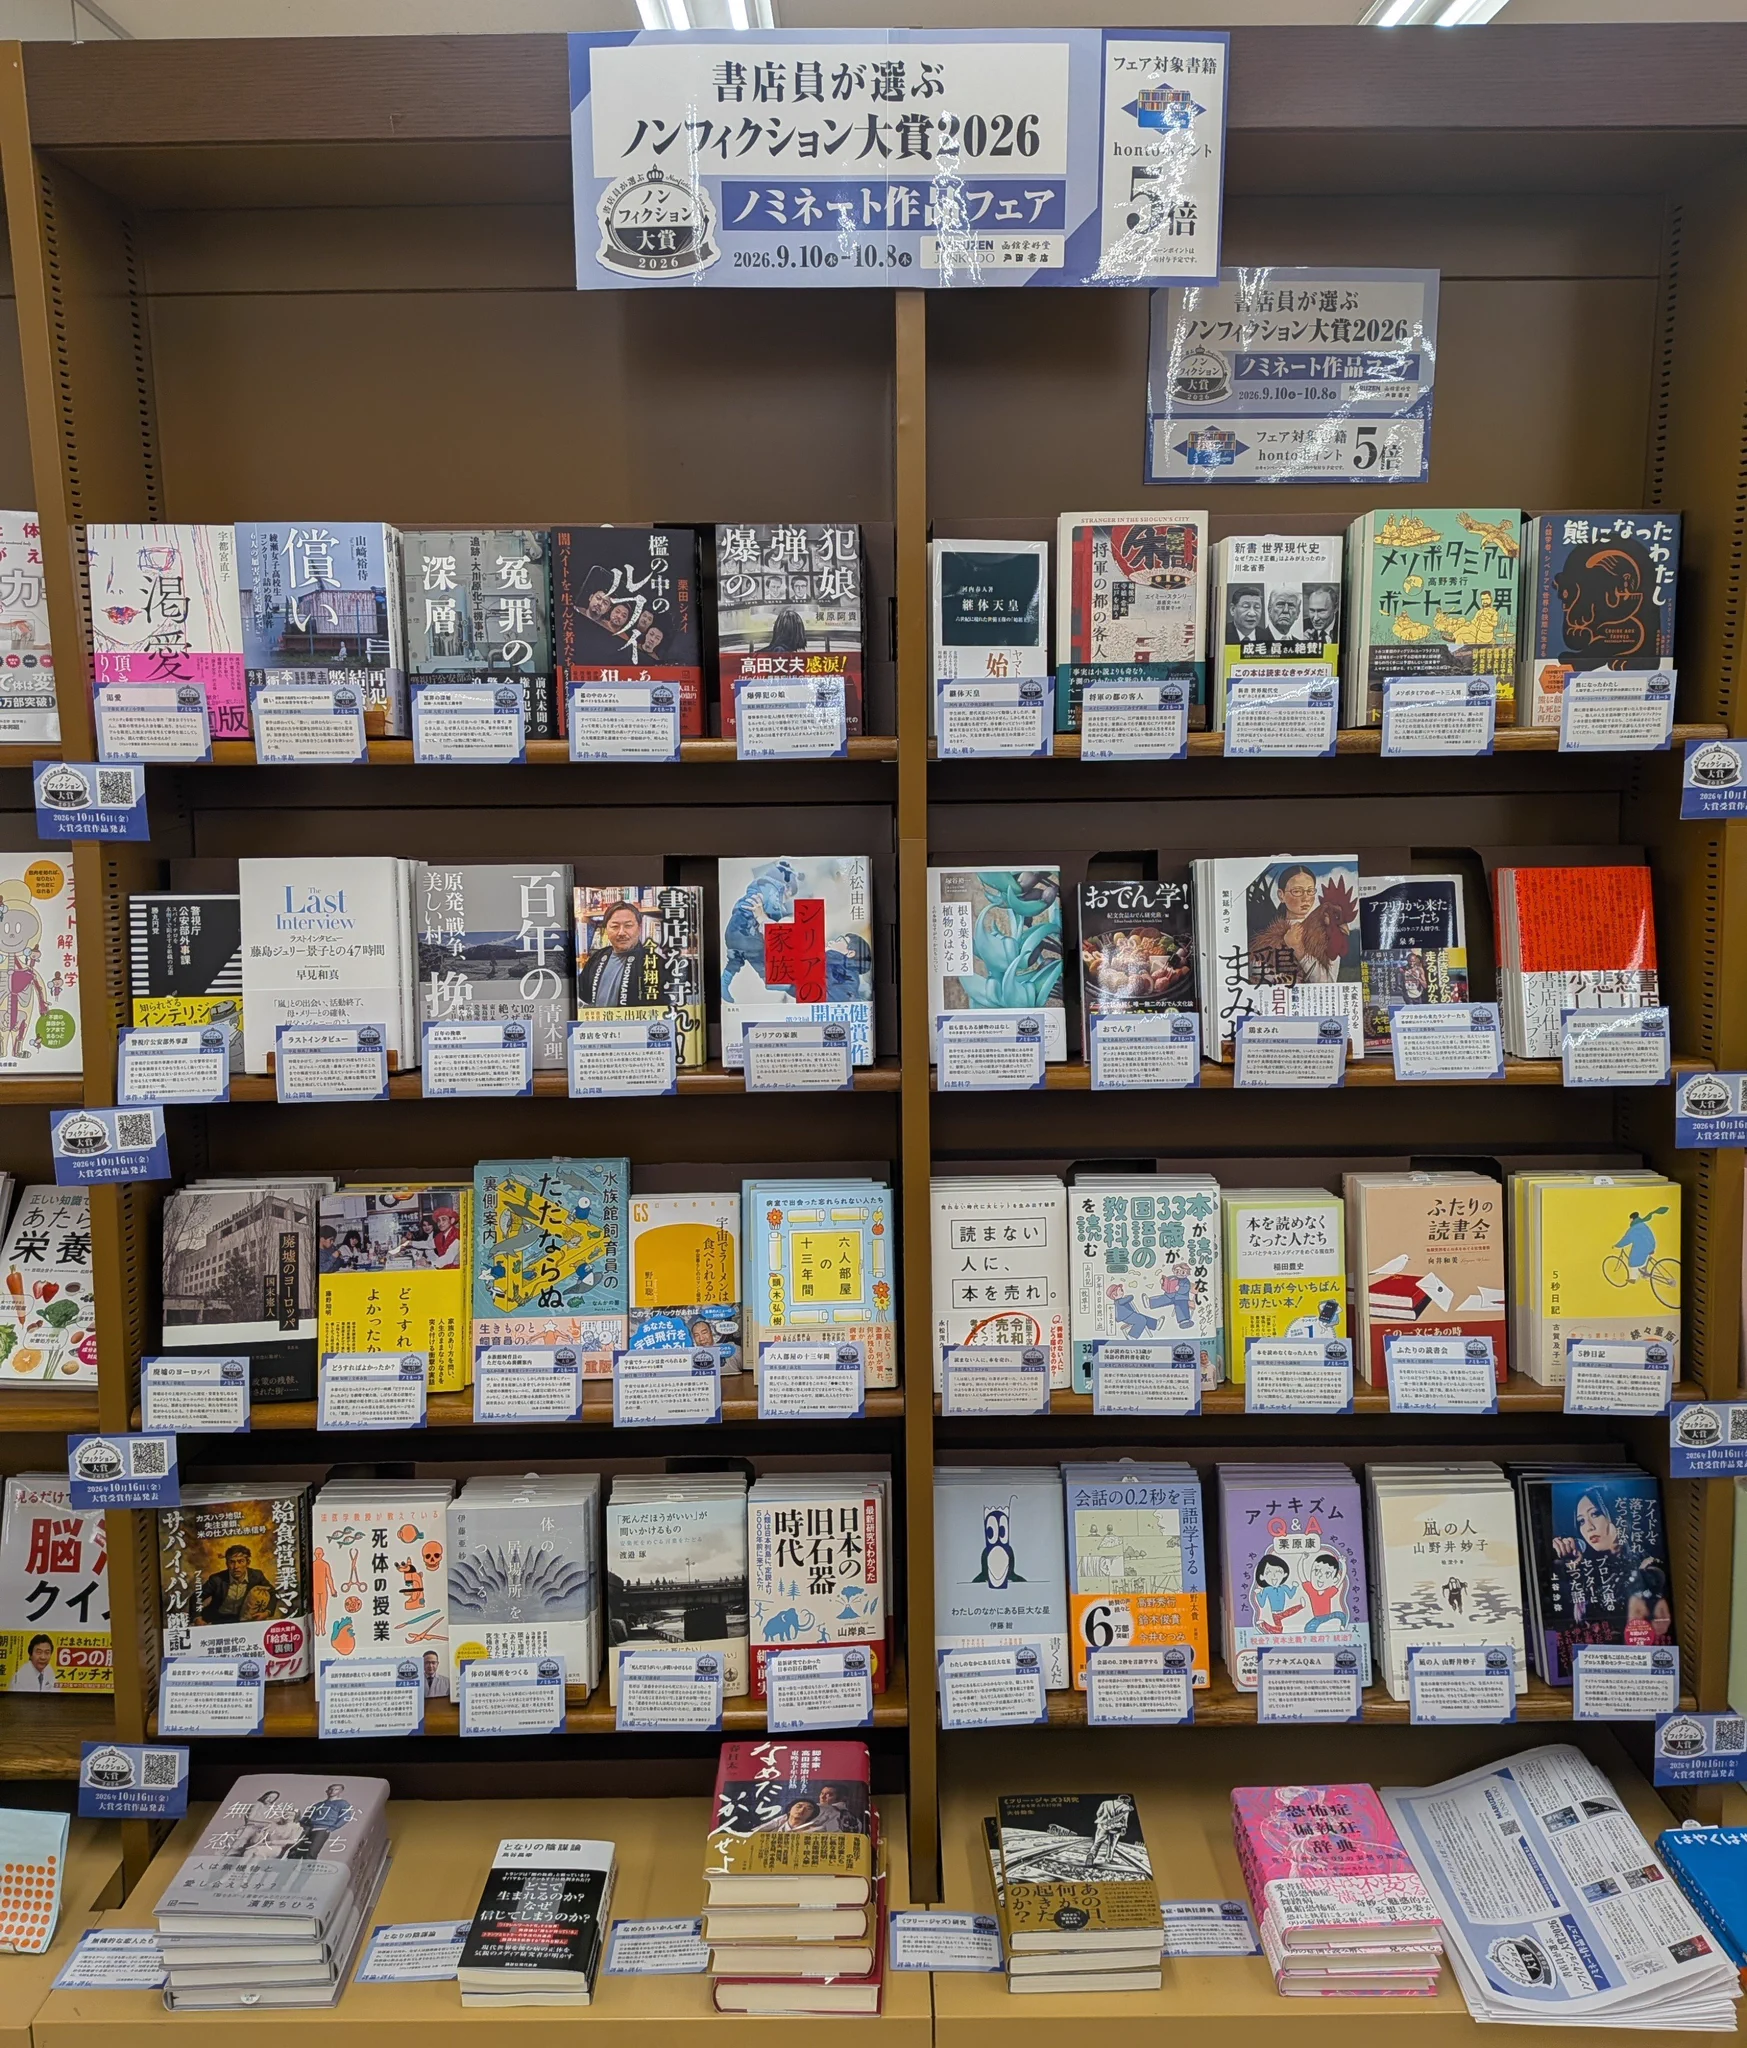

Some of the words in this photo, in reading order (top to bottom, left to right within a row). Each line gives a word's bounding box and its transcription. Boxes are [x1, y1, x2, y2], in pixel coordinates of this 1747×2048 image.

[1113, 56, 1217, 75] フェア対象書籍
[712, 60, 945, 103] 書店員が選ぶ
[620, 112, 1041, 160] ノンフィクション大賞2026
[641, 190, 670, 205] ノン
[742, 186, 1051, 227] ノミネート作品フェア
[619, 207, 693, 224] フィクション
[636, 230, 676, 251] 大賞
[639, 257, 678, 268] 2026
[1184, 319, 1408, 344] ノンフィクション大賞2026
[721, 527, 858, 562] 爆弾犯
[1563, 519, 1673, 544] 熊になった
[1235, 543, 1257, 554] 新書
[1262, 543, 1320, 554] 世界現代史
[1381, 541, 1514, 580] メソポタミアの
[280, 528, 340, 632] 償い
[648, 535, 670, 614] 檻の中の
[1234, 564, 1265, 572] 川北省吾
[1428, 577, 1468, 586] 高野秀行
[1650, 544, 1674, 606] わたし
[421, 556, 458, 635] 深層
[470, 536, 484, 641] 追跡・大川原化工機事件
[725, 566, 858, 600] の娘
[495, 555, 533, 666] 冤罪の
[1092, 542, 1109, 659] 将軍の都の客人
[1380, 588, 1512, 616] ボート三人男
[602, 564, 653, 665] ルフィ
[741, 656, 848, 674] 高田文夫感涙!
[1234, 668, 1328, 677] この本は読まなきゃダメだ!
[746, 691, 785, 699] 爆弾犯の娘
[949, 689, 980, 697] 継体天皇
[1089, 693, 1143, 701] 将軍の都の客人
[58, 824, 127, 834] 大賞受賞作品発表
[284, 885, 348, 914] Last
[850, 861, 865, 921] 小松由佳
[1085, 884, 1190, 910] おでん学!
[423, 872, 443, 945] 美しい村
[444, 872, 466, 960] 原発、戦争、
[1369, 900, 1448, 912] アフリカから来た
[191, 906, 201, 935] 警視庁
[276, 915, 356, 930] Interview
[179, 907, 191, 965] 公安部外事課
[513, 871, 564, 1001] 百年の
[942, 905, 954, 973] 植物のはなし
[958, 905, 970, 973] 根も葉もある
[250, 945, 385, 958] 藤島ジュリー景子との47時間
[768, 926, 795, 982] 家族
[799, 903, 823, 1002] シリアの
[296, 969, 339, 980] 早見和真
[643, 940, 659, 1000] 今村翔吾
[658, 889, 693, 1064] 書店を守れ!
[620, 962, 632, 1006] HONMARU
[544, 1004, 563, 1061] 青木理
[579, 1031, 621, 1039] 書店を守れ!
[754, 1031, 797, 1039] シリアの家族
[482, 1176, 498, 1244] 裏側案内
[633, 1203, 648, 1222] GS
[766, 1197, 884, 1206] 病室で出会った忘れられない人たち
[1427, 1198, 1493, 1217] ふたりの
[602, 1171, 619, 1290] 水族館飼育員の
[959, 1226, 1039, 1243] 読まない
[1246, 1215, 1325, 1231] 本を読めなく
[1429, 1218, 1491, 1241] 読書会
[9, 1230, 92, 1265] 栄養
[538, 1173, 565, 1309] ただならぬ
[1249, 1231, 1327, 1247] なった人たち
[703, 1237, 716, 1301] 食べられるか
[716, 1217, 729, 1301] 宇宙でラーメンは
[801, 1237, 814, 1297] 十三年間
[838, 1237, 852, 1295] 六人部屋
[961, 1257, 1013, 1272] 人に、
[1273, 1262, 1304, 1271] 稲田豊史
[282, 1235, 296, 1330] 廃墟のヨーロッパ
[962, 1283, 1057, 1302] 本を売れ。
[1238, 1281, 1340, 1294] 書店員が今いちばん
[1551, 1270, 1560, 1316] 5秒日記
[772, 1277, 782, 1326] 頭木弘樹
[1239, 1296, 1303, 1309] 売りたい本!
[1397, 1346, 1448, 1355] ふたりの読書会
[153, 1368, 210, 1376] 廃墟のヨーロッパ
[332, 1363, 395, 1372] どうすればよかったか?
[1075, 1489, 1181, 1507] 会話の0.2秒を
[1246, 1497, 1344, 1525] アナキズム
[617, 1511, 708, 1525] 「死んだほうがいい」が
[619, 1526, 681, 1537] 問いかけるもの
[1181, 1488, 1199, 1575] 言語学する
[1267, 1516, 1322, 1537] Q&A
[1614, 1496, 1628, 1546] だった私が
[1629, 1498, 1644, 1554] 落ちこぼれ
[1645, 1499, 1657, 1546] アイドルで
[540, 1517, 555, 1553] 体の
[774, 1508, 804, 1568] 時代
[837, 1508, 862, 1580] 日本の
[865, 1506, 876, 1582] 最新研究でわかった
[1278, 1538, 1316, 1550] 栗原康
[1413, 1540, 1488, 1555] 山野井妙子
[272, 1501, 298, 1620] 給食営業マン
[807, 1508, 836, 1596] 旧石器
[163, 1511, 192, 1651] サバイバル戦記
[475, 1543, 487, 1599] つくる
[508, 1540, 522, 1620] 居場所を
[1566, 1559, 1586, 1604] 立った話
[1583, 1557, 1598, 1604] センターに
[1596, 1555, 1617, 1612] プロレス界の
[371, 1529, 390, 1642] 死体の授業
[952, 1605, 1050, 1617] わたしのなかにある巨大な星
[837, 1626, 877, 1637] 山岸良二
[1085, 1606, 1111, 1647] 6
[471, 1669, 528, 1677] 体の居場所をつくる
[949, 1658, 1011, 1667] わたしのなかにある巨大な星
[1268, 1658, 1322, 1666] アナキズムQ&A
[223, 1800, 363, 1822] 無機的な
[1286, 1803, 1352, 1818] 恐怖症
[204, 1831, 348, 1853] 恋人たち
[503, 1842, 582, 1852] となりの陰謀論
[1312, 1840, 1358, 1854] 辞典
[497, 1890, 585, 1902] 生まれるのか?
[526, 1882, 563, 1891] どこで
[480, 1910, 591, 1923] 信じてしまうのか?
[524, 1901, 552, 1910] なぜ
[383, 1931, 436, 1940] となりの陰謀論
[623, 1924, 688, 1932] なめたらいかんぜよ
